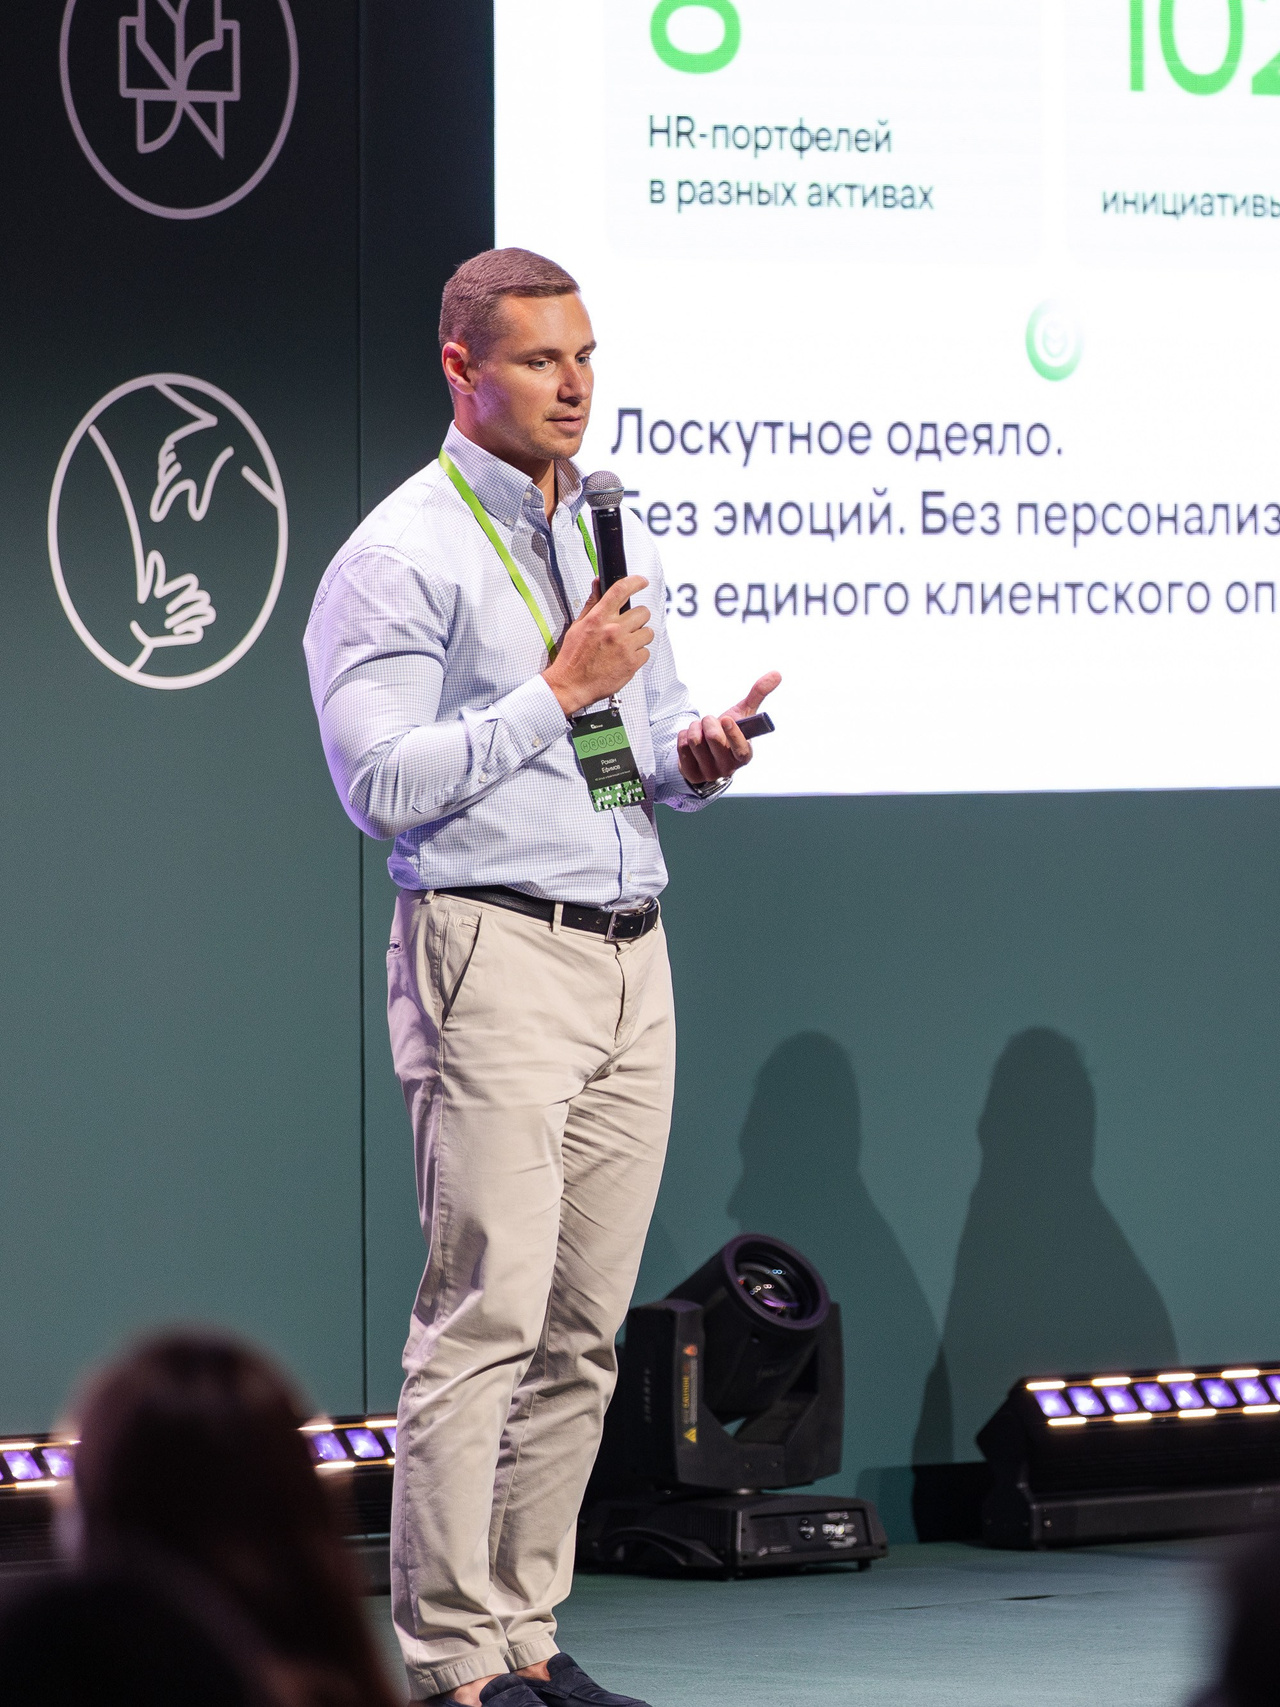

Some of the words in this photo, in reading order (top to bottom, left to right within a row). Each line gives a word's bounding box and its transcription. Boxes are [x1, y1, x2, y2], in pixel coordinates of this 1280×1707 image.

[648, 114, 893, 159] HR-портфелей
[649, 178, 666, 205] в
[677, 179, 797, 214] разных
[807, 182, 934, 210] активах
[610, 407, 873, 467] Лоскутное
[887, 421, 1063, 462] одеяло.
[714, 487, 906, 543] эмоций.
[921, 490, 1000, 536] Без
[714, 581, 910, 624] единого
[926, 580, 1211, 615] клиентского
